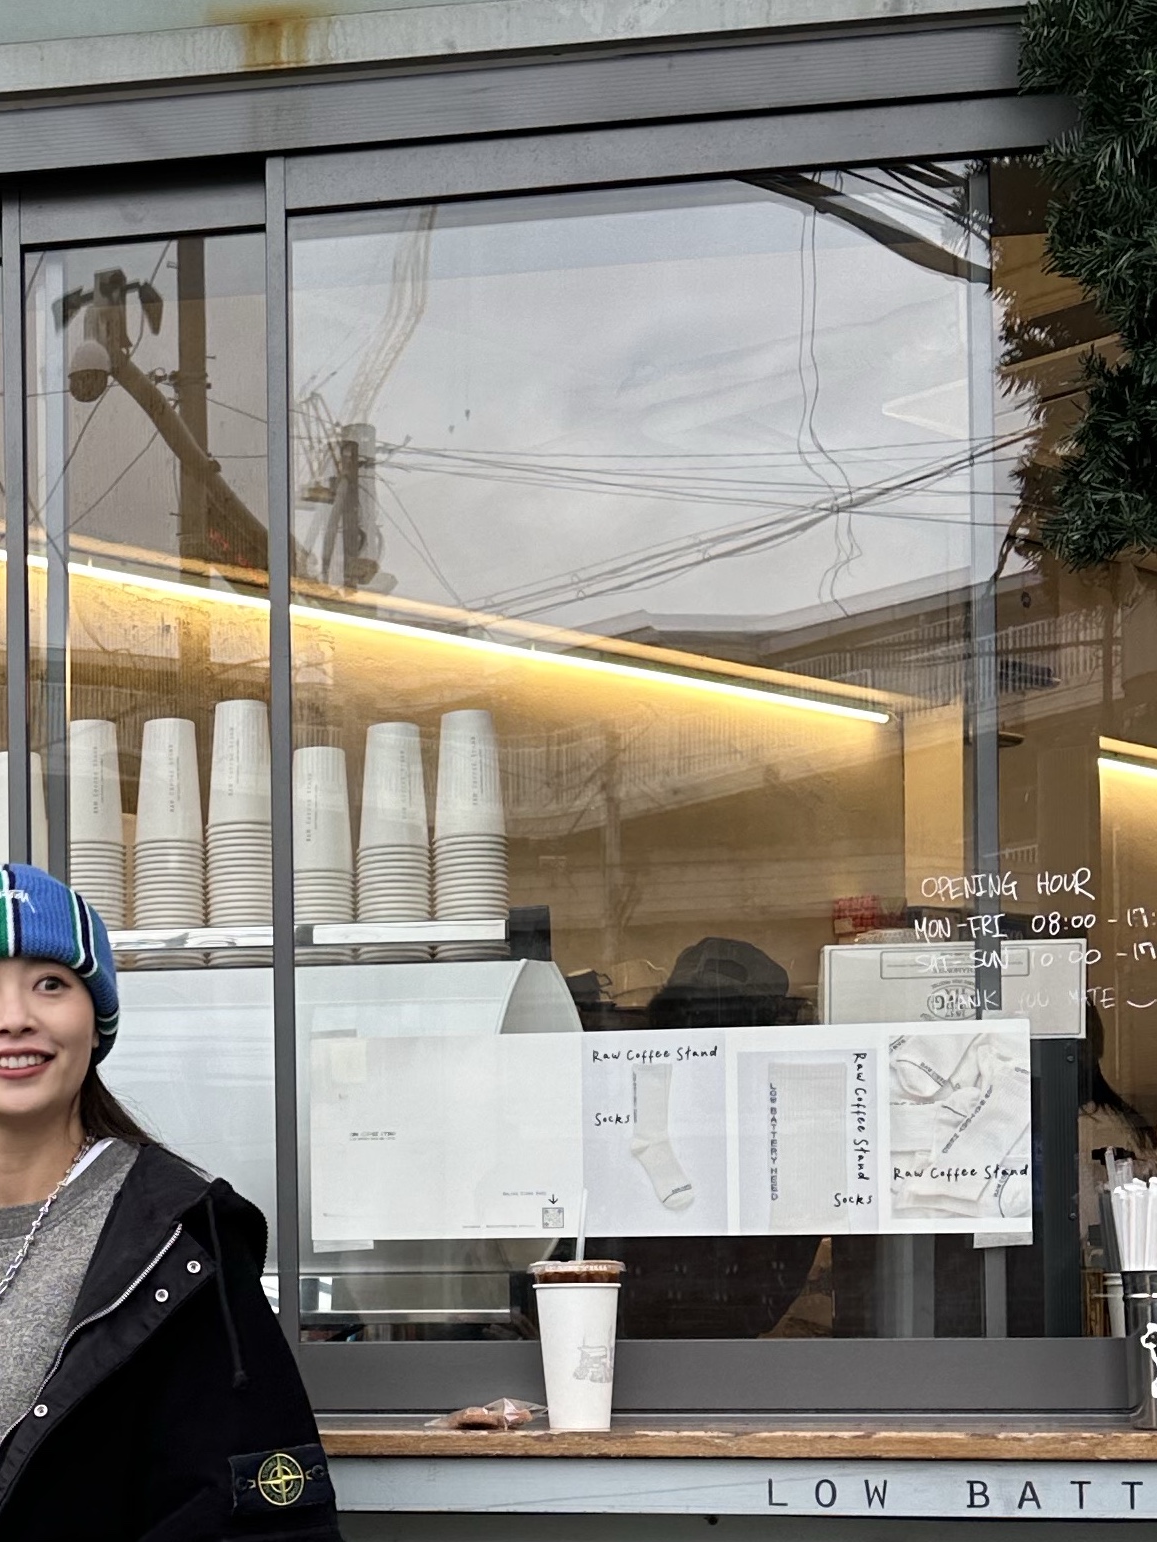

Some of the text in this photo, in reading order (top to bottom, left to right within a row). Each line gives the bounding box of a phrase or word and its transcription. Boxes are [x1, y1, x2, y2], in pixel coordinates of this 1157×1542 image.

[921, 867, 1096, 901] OPENING HOUR
[1031, 911, 1096, 935] 08:00
[592, 1045, 718, 1064] Raw Coffee Stand
[594, 1112, 631, 1127] Socks
[850, 1052, 871, 1181] Raw Coffee Stand
[770, 1106, 778, 1165] BATTERY
[893, 1166, 924, 1181] Raw
[930, 1166, 978, 1183] Coffee
[984, 1164, 1029, 1180] Stand
[833, 1192, 873, 1208] Socks
[767, 1478, 1144, 1510] LOW BATT
